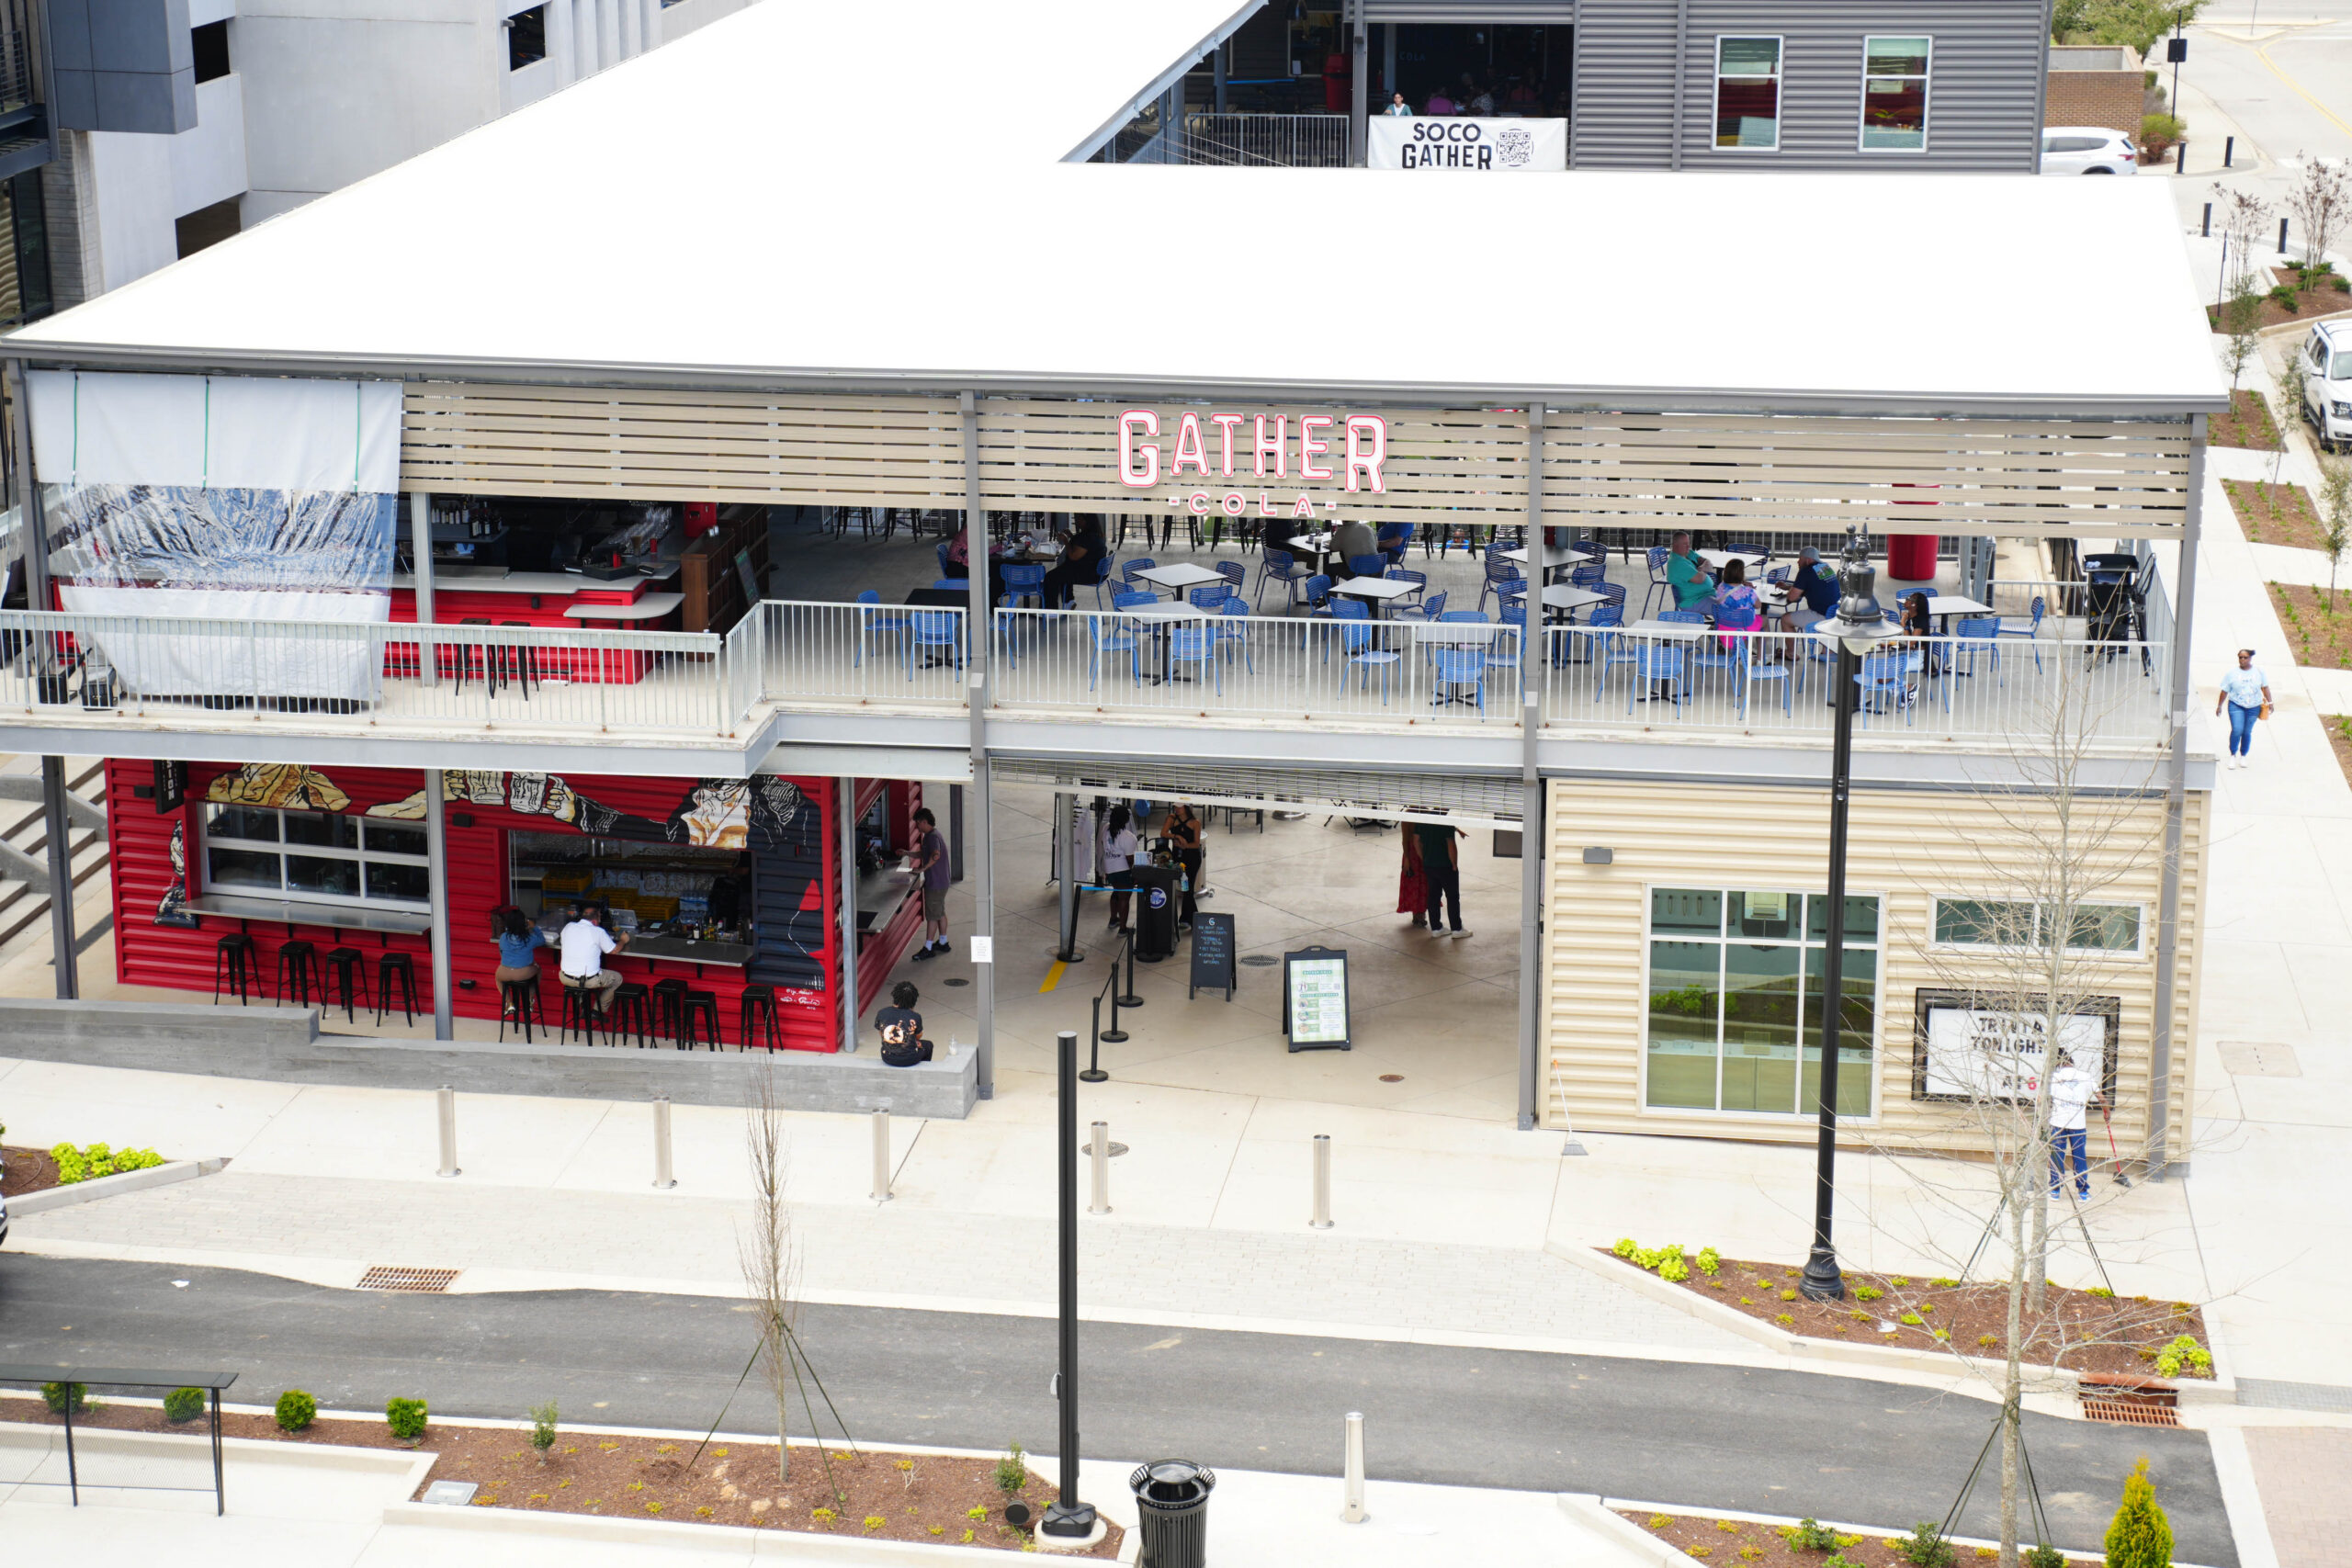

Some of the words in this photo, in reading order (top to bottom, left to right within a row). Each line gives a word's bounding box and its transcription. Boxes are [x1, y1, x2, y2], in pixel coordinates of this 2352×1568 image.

[1413, 122, 1482, 142] SOCO
[1402, 143, 1492, 170] GATHER
[1118, 409, 1387, 494] GATHER
[1971, 1036, 2047, 1054] TONIGHT
[2028, 1077, 2037, 1090] 6
